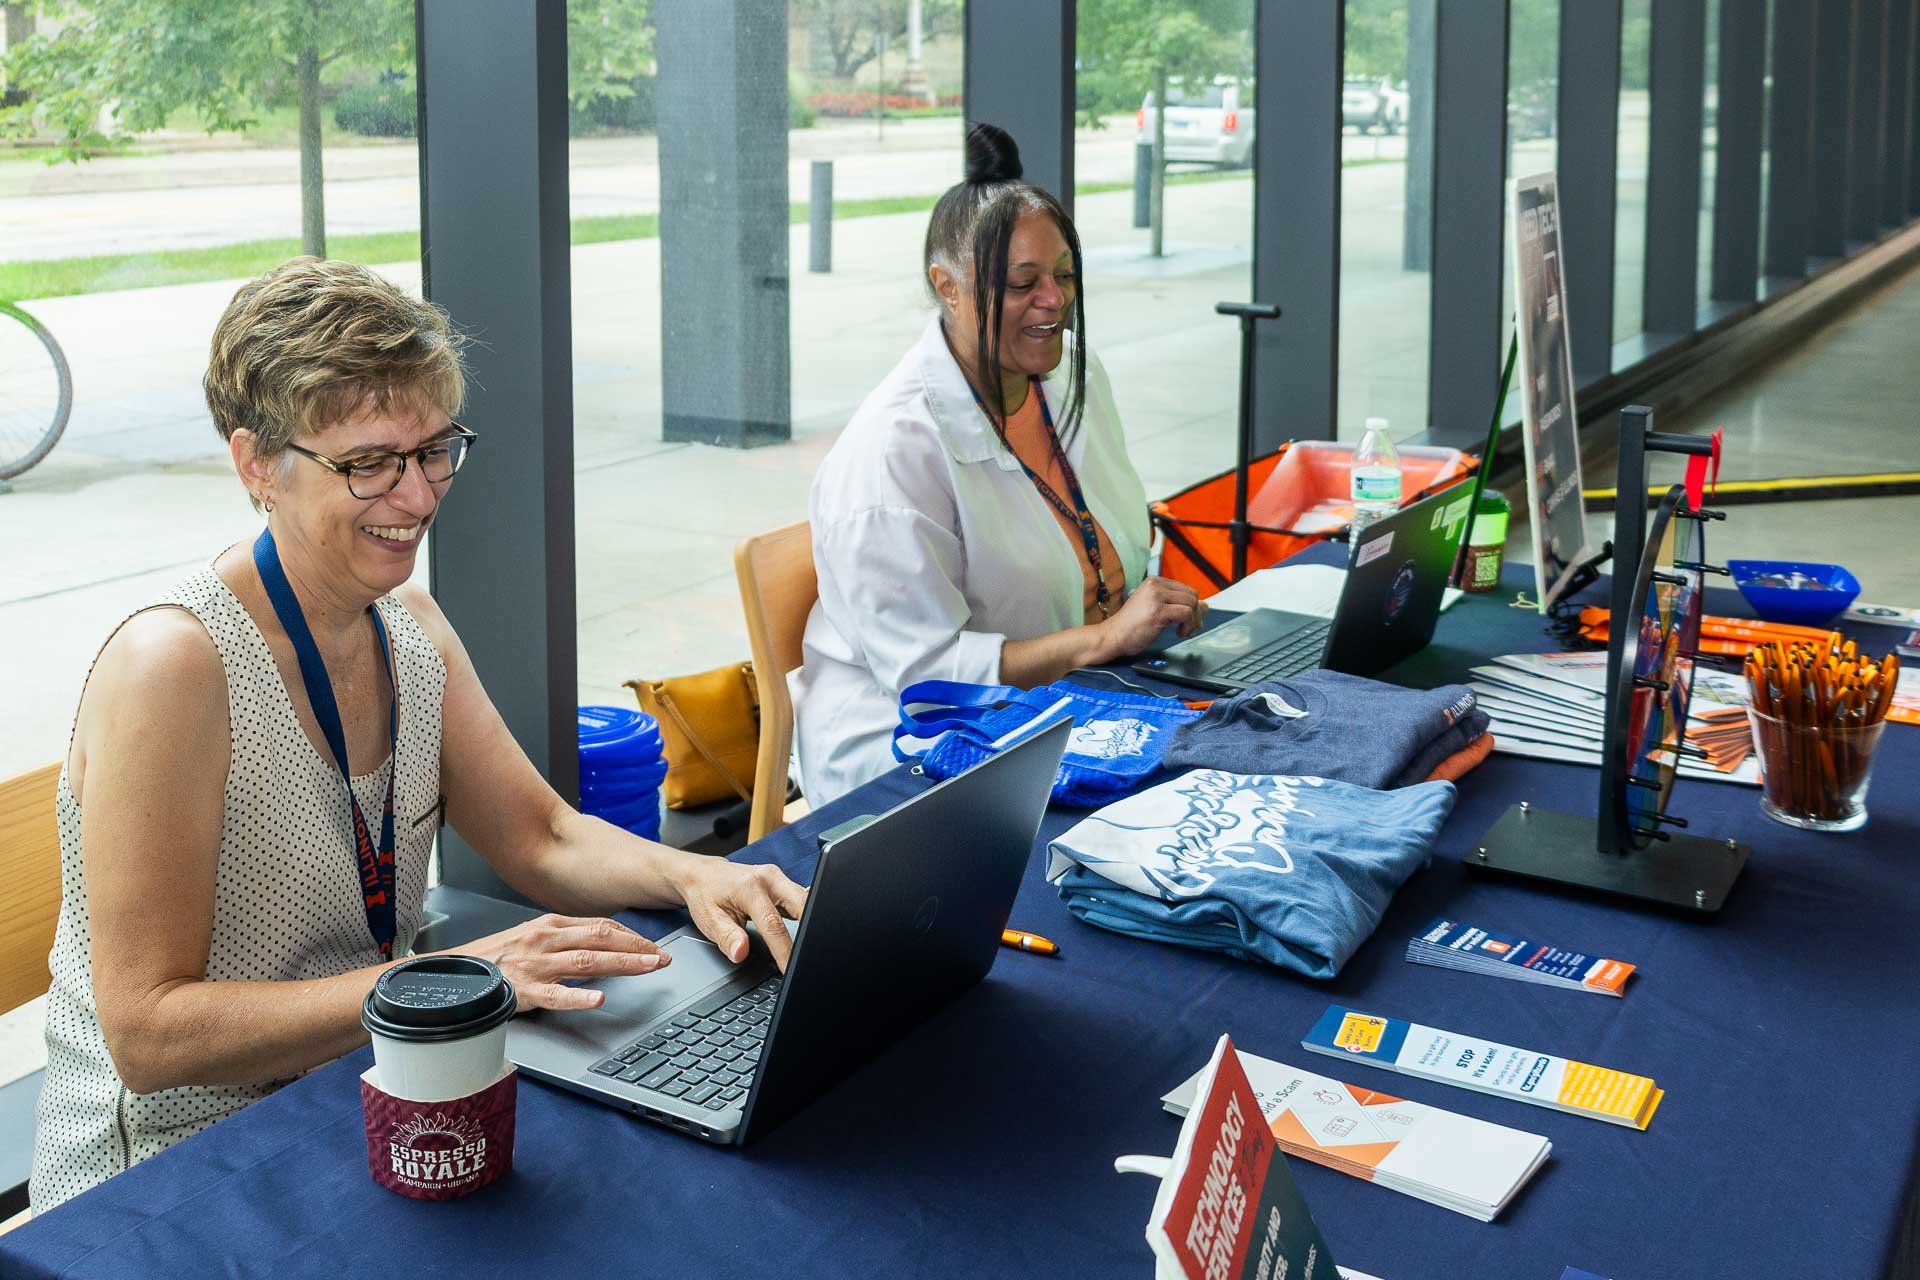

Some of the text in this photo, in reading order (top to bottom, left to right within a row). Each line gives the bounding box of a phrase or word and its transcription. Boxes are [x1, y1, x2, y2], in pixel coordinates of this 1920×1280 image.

[1450, 693, 1475, 718] ILLINOIS
[353, 801, 380, 888] ILLINOIS
[1456, 1049, 1476, 1069] STOP
[1276, 1078, 1303, 1099] Scam
[389, 1137, 487, 1164] ESPRESSO
[390, 1151, 486, 1180] ROYALE
[1186, 1089, 1246, 1269] TECHNOLOGY
